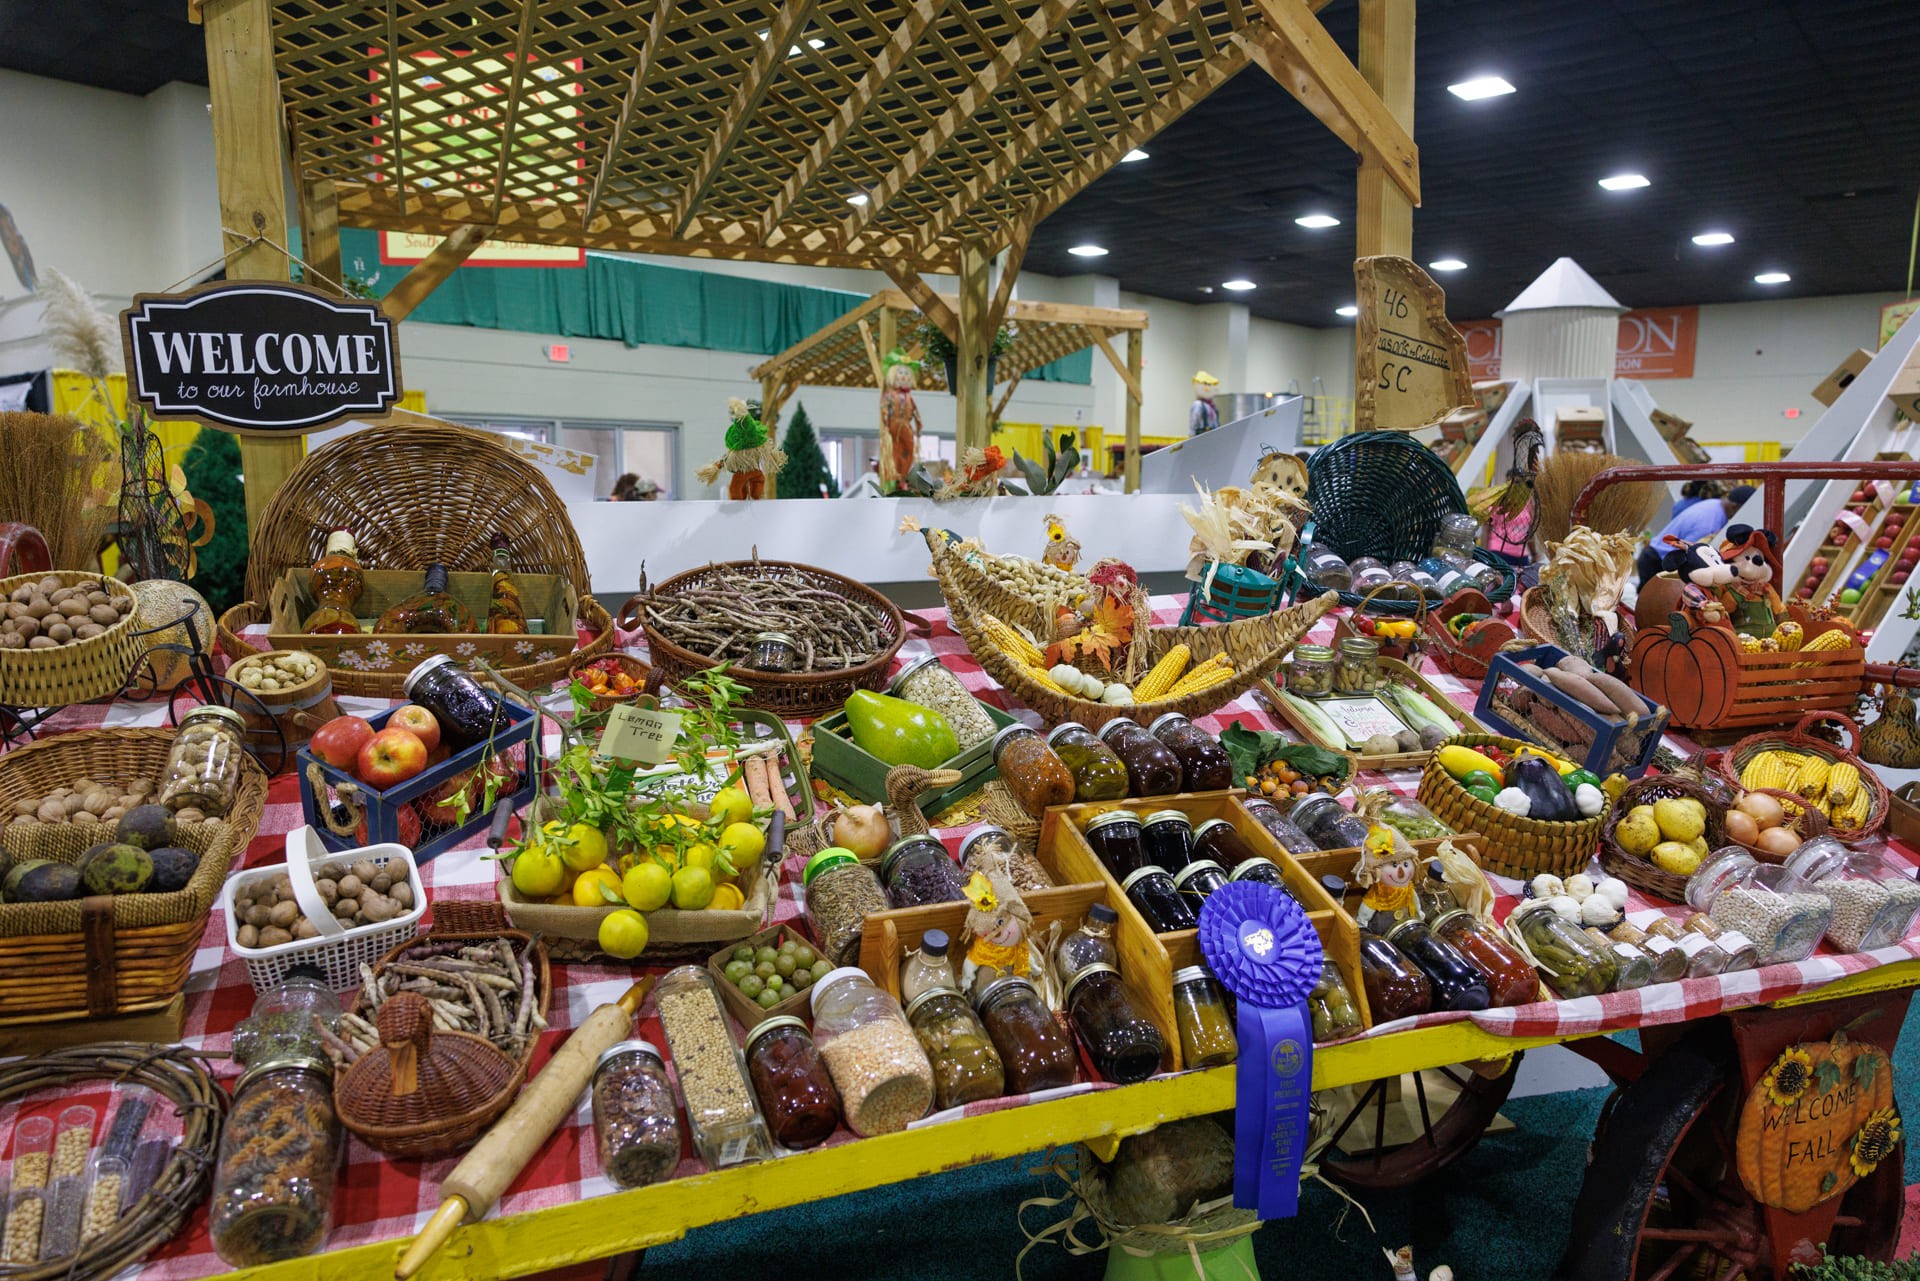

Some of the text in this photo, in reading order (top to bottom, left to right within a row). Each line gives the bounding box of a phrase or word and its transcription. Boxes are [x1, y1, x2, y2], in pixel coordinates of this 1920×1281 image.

[1384, 288, 1408, 319] 46
[149, 331, 380, 375] WELCOME
[177, 375, 361, 410] to our farmhouse
[1378, 362, 1412, 393] SC
[1762, 1083, 1857, 1132] WELCOME
[1786, 1129, 1836, 1169] FALL
